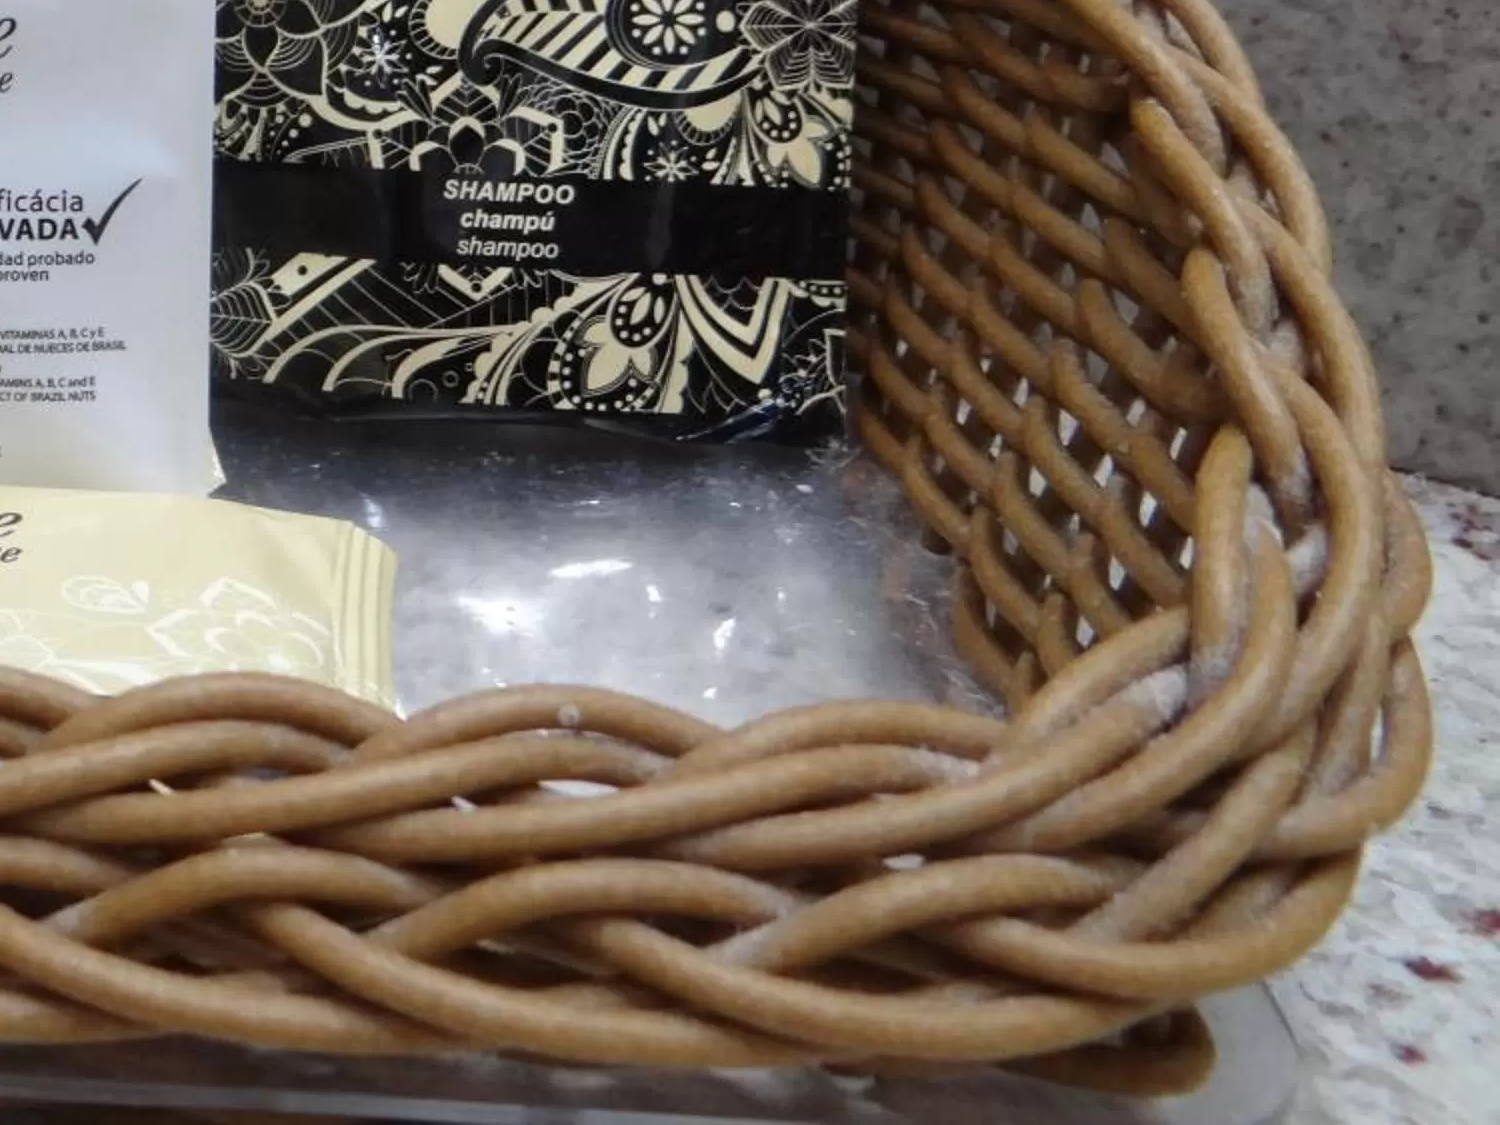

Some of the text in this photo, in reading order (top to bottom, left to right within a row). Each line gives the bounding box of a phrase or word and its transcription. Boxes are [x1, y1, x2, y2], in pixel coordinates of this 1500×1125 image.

[442, 178, 576, 205] SHAMPOO
[459, 208, 556, 235] champú
[27, 250, 96, 268] probado
[456, 235, 560, 262] shampoo
